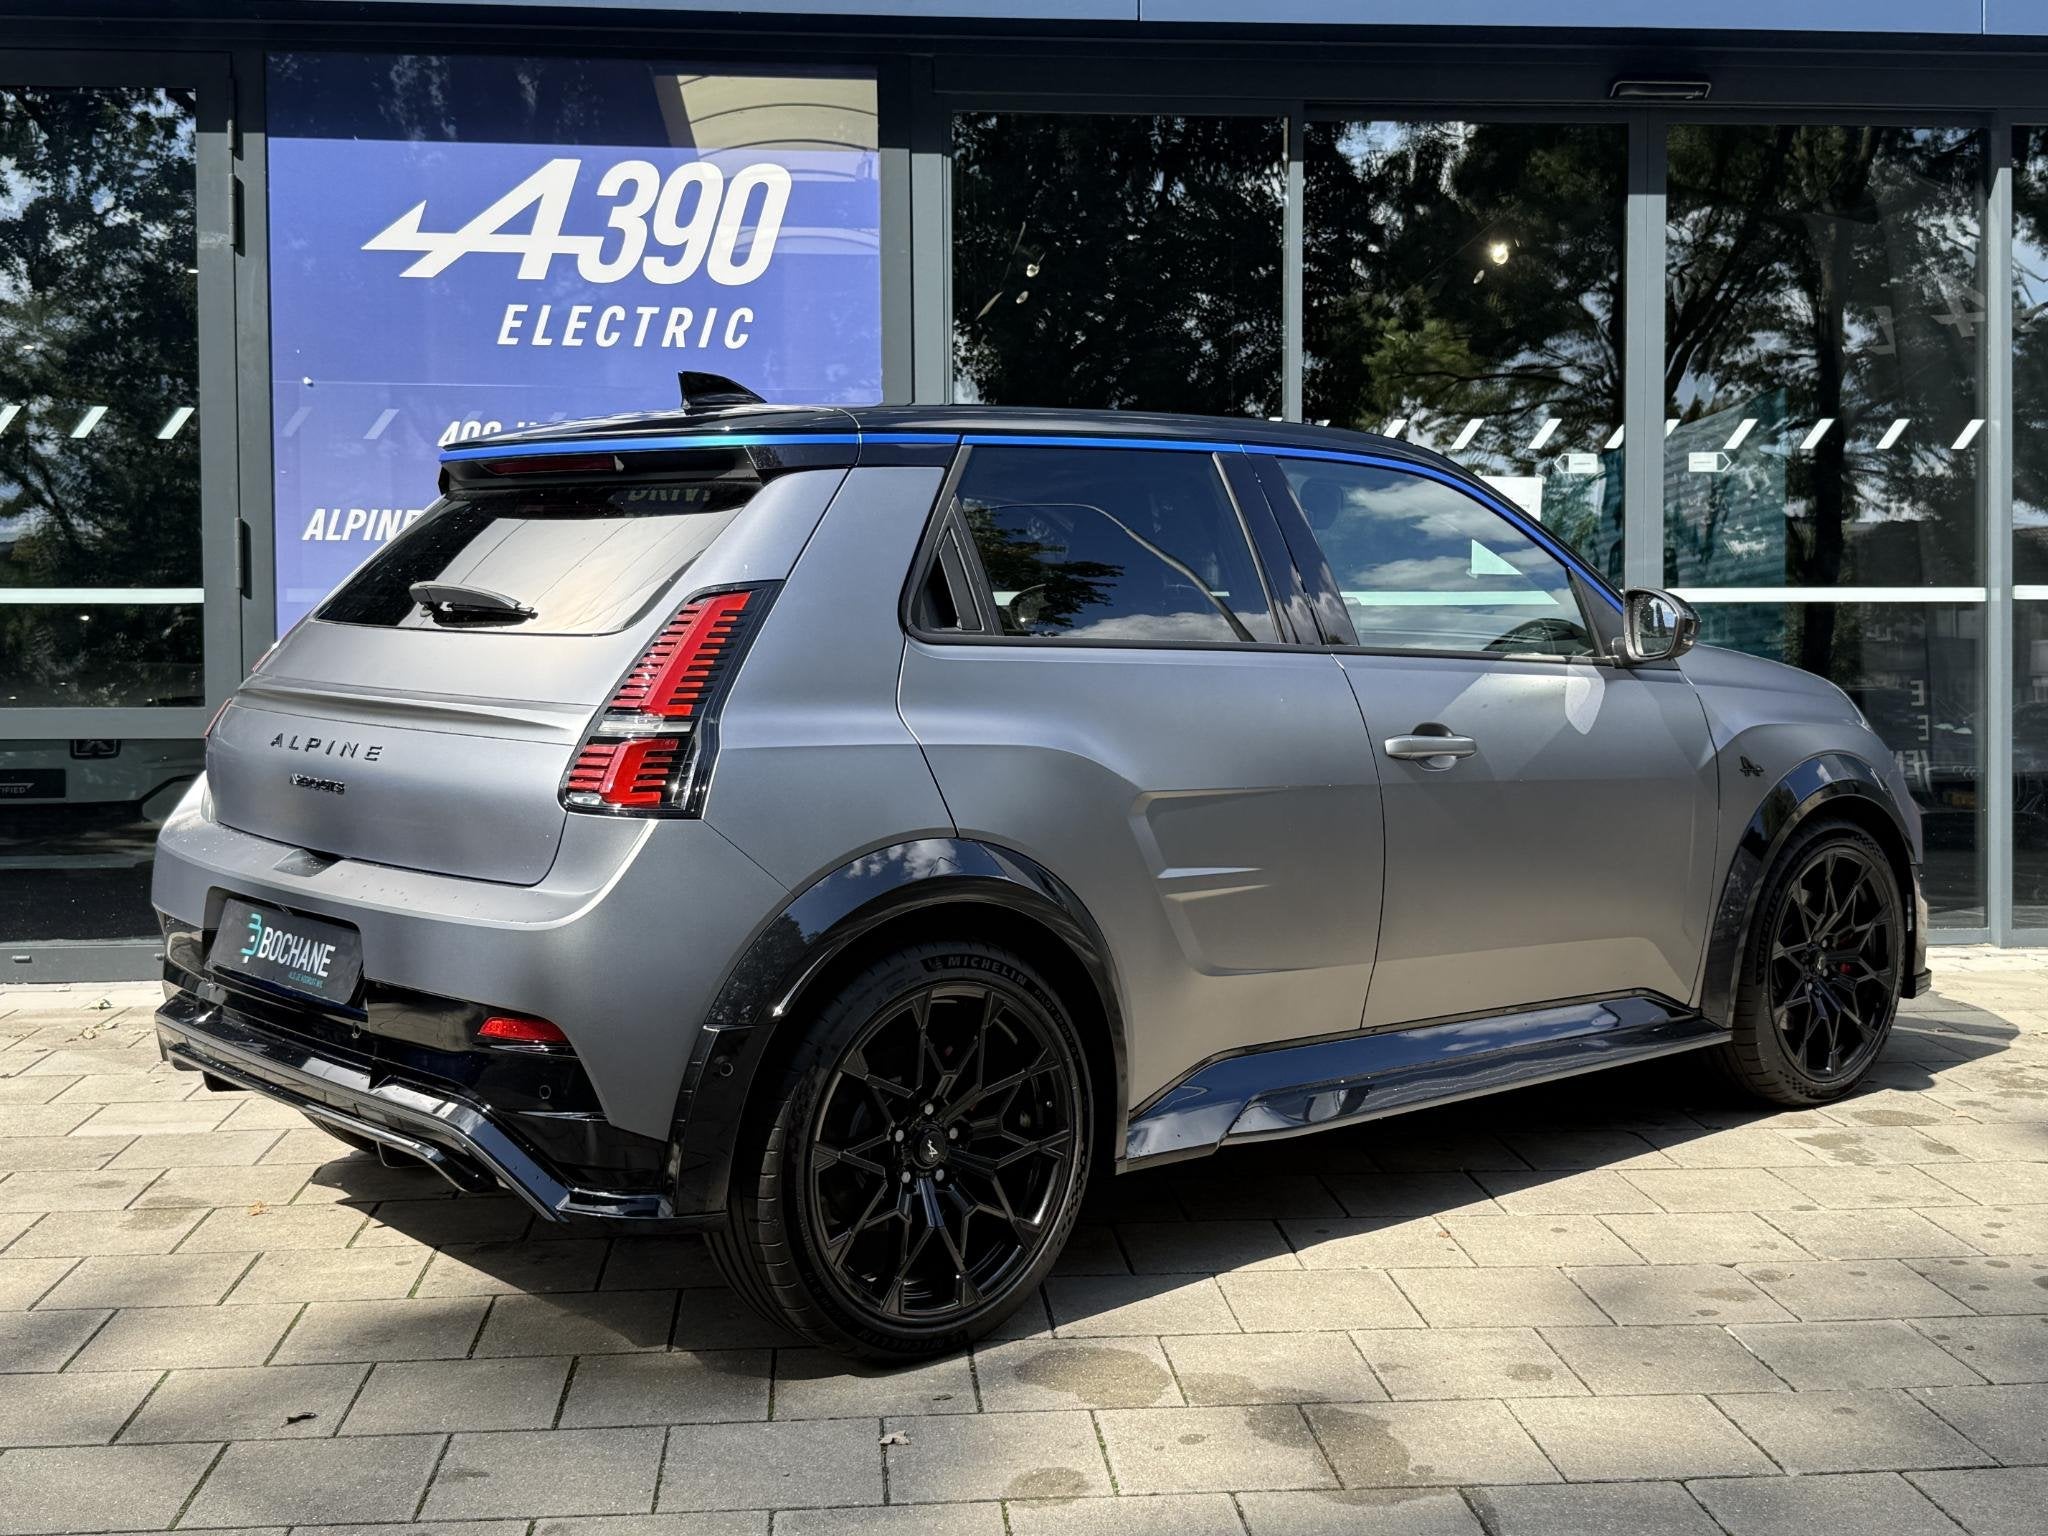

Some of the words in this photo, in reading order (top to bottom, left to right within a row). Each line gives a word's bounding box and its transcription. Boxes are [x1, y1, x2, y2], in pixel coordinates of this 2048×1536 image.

[361, 158, 792, 286] A390
[497, 303, 755, 350] ELECTRIC
[269, 732, 384, 762] ALPINE
[257, 926, 336, 977] BOCHANE
[948, 955, 1028, 986] MICHELIN
